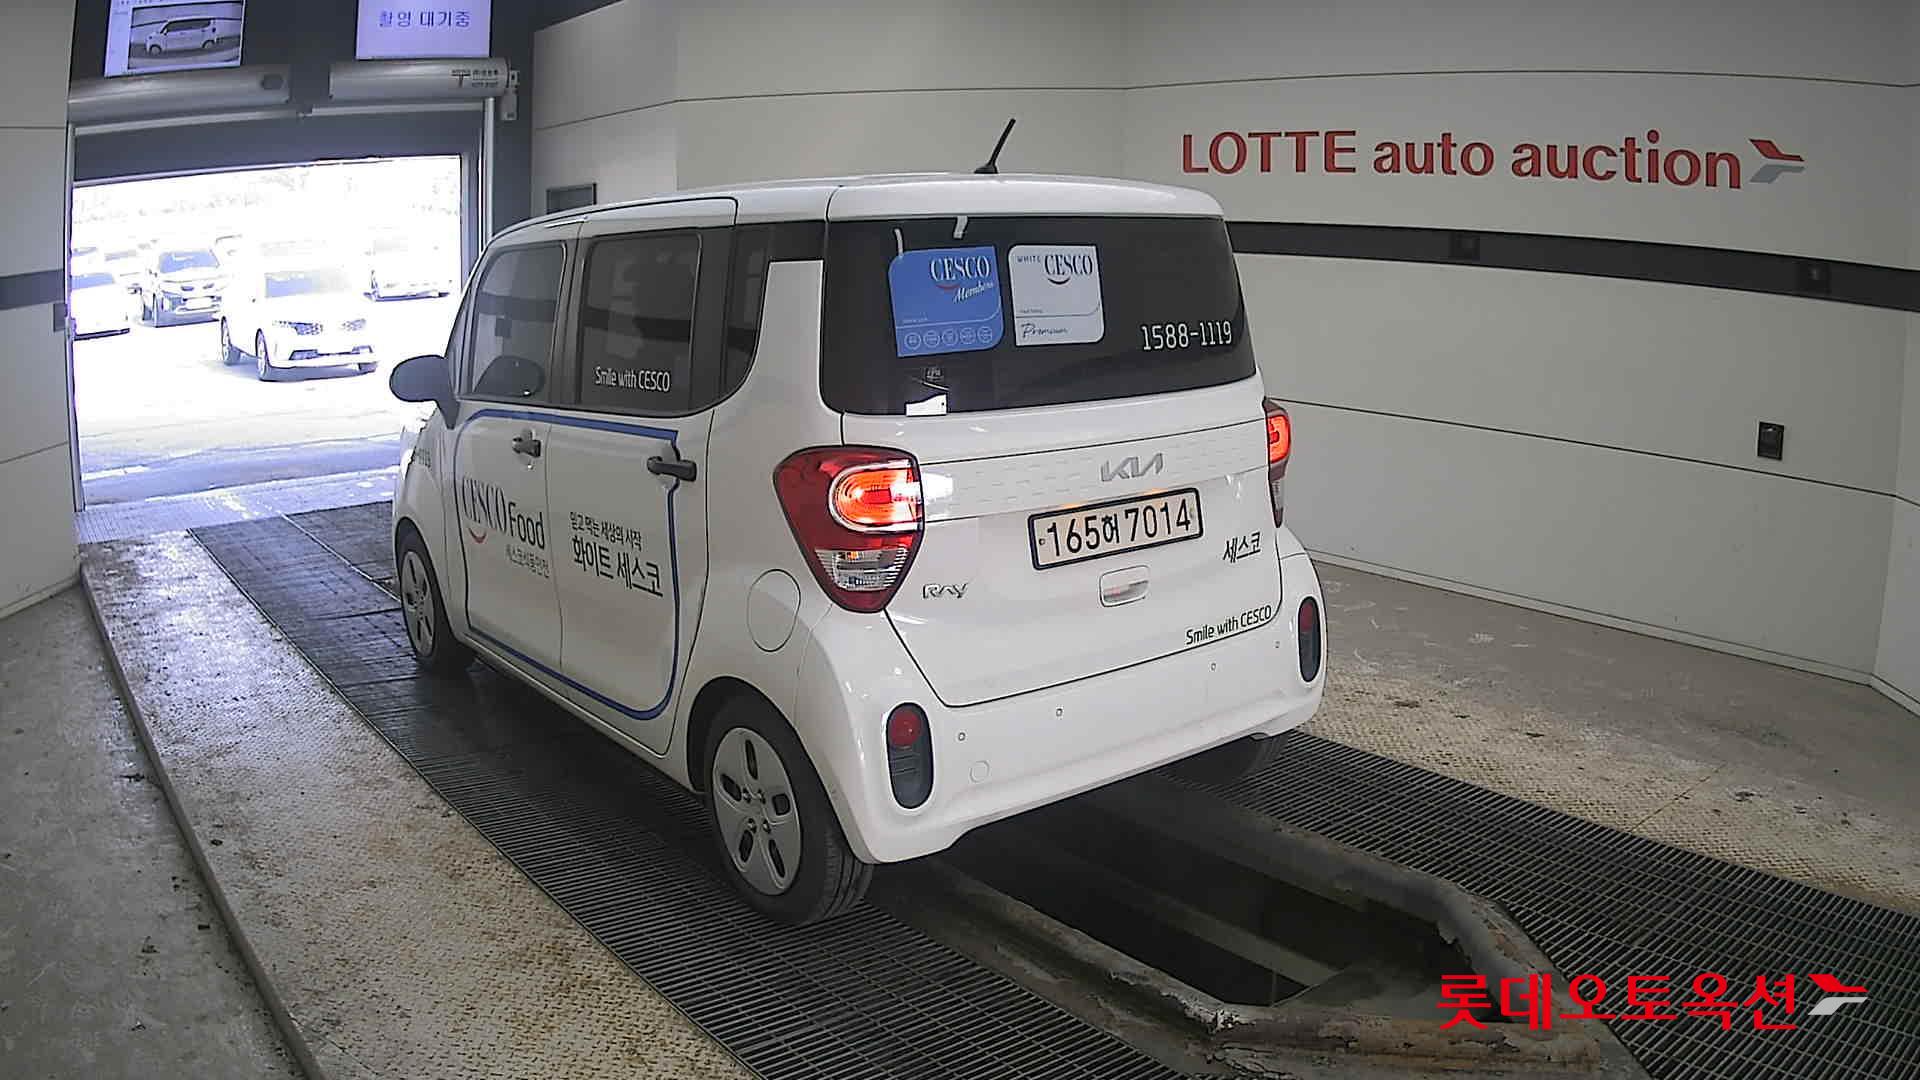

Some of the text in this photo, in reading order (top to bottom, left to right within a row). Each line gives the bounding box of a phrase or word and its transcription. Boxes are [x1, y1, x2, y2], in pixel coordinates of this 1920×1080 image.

[420, 10, 470, 28] 대기중
[1182, 128, 1742, 189] LOTTE auto auction
[930, 255, 990, 282] CESCO
[1044, 254, 1093, 275] CESCO
[1141, 320, 1233, 352] 1588-1119
[595, 366, 670, 392] Smile with CESCO
[1100, 453, 1164, 482] KIA
[1047, 498, 1191, 557] 165허 7014
[1222, 531, 1261, 563] 세스코
[571, 534, 663, 597] 화이트 세스코
[922, 582, 970, 599] RAY
[1186, 604, 1272, 645] Smile with CESCO
